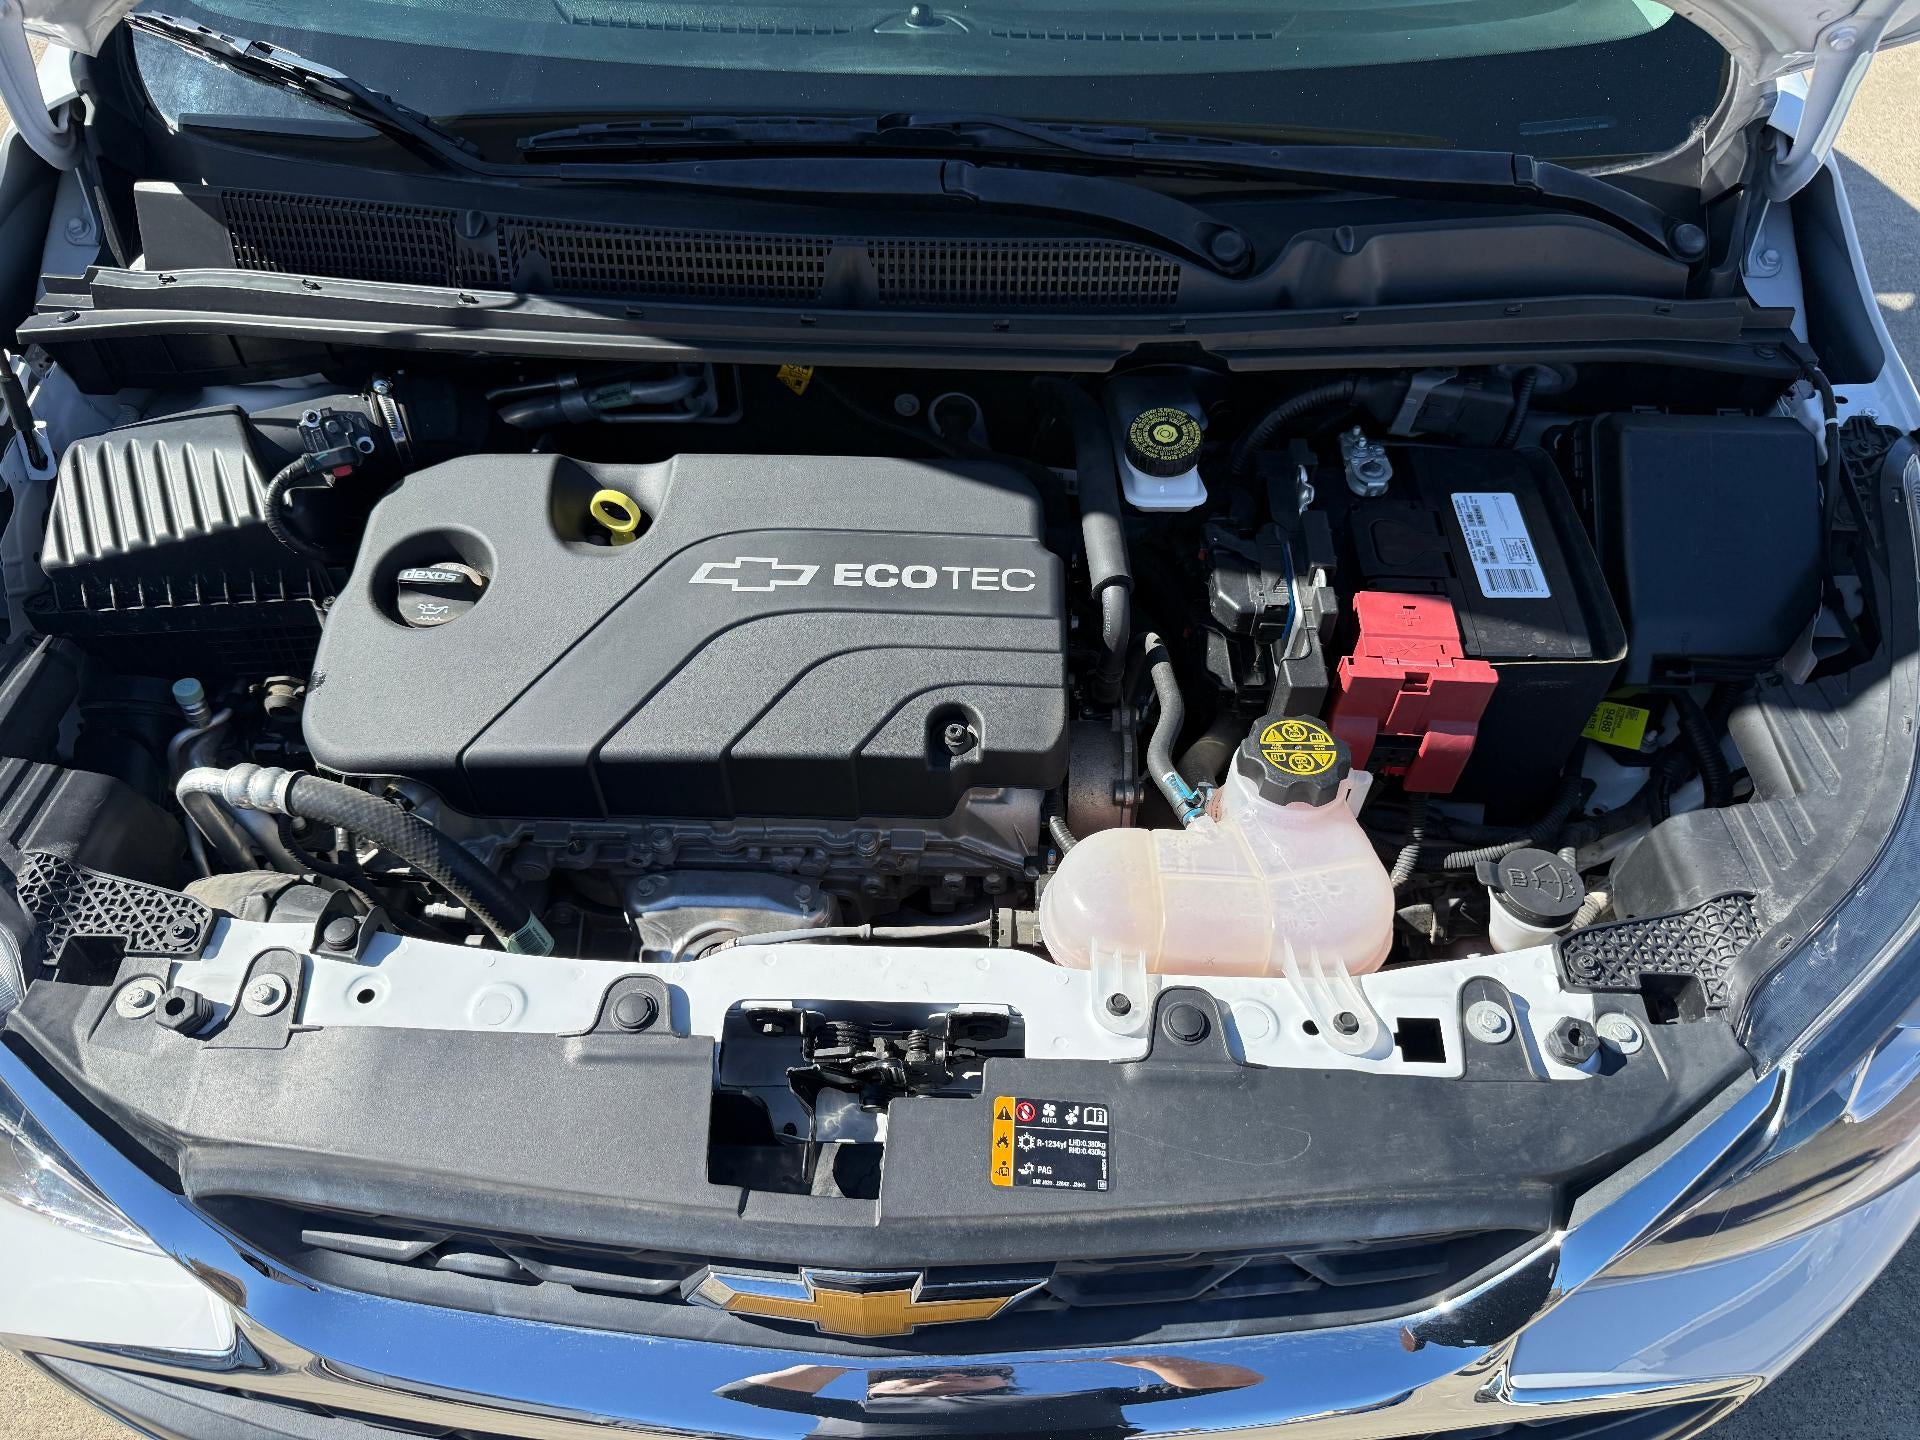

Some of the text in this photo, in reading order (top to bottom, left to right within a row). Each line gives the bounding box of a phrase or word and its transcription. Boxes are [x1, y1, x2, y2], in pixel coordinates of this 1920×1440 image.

[403, 568, 461, 582] dexos
[833, 563, 1036, 592] ECOTEC
[1037, 1139, 1067, 1149] R-1234yf
[1037, 1166, 1052, 1174] PAG
